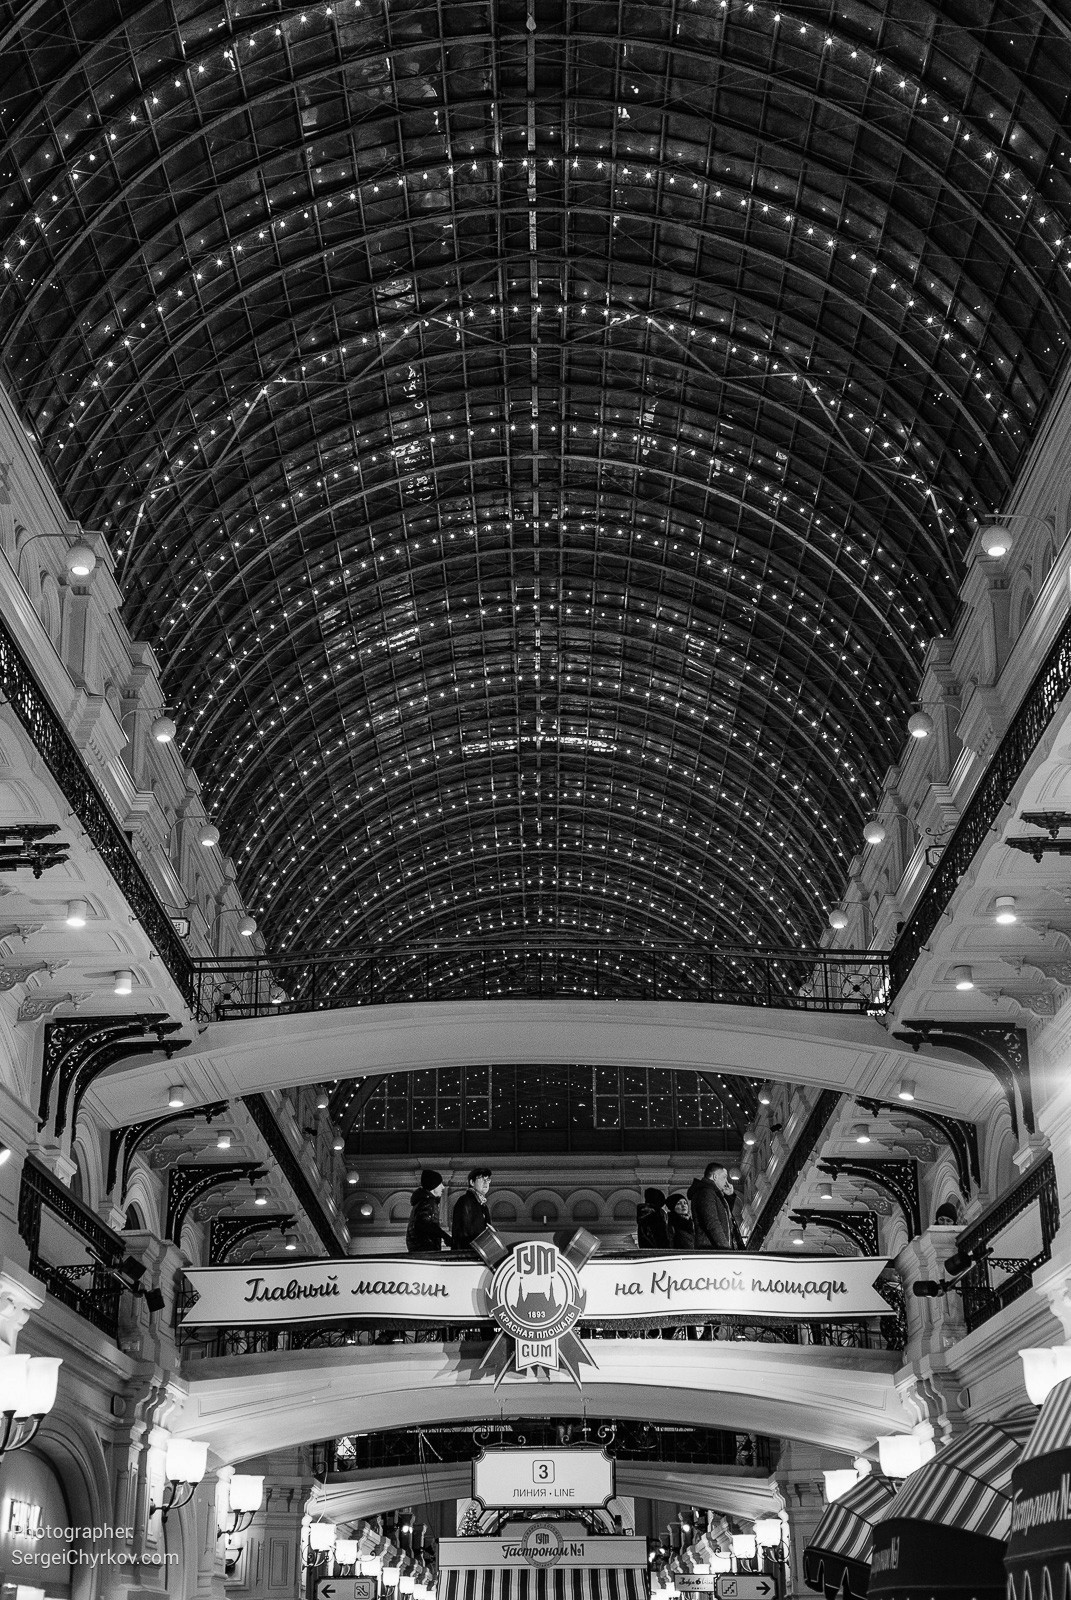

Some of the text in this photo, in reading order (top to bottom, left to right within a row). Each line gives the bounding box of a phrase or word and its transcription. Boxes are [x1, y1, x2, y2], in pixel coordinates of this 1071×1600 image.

[516, 1245, 556, 1275] ГУМ
[244, 1276, 449, 1302] Главный магазин
[615, 1271, 848, 1301] на Красной площади
[527, 1311, 546, 1319] 1893
[499, 1311, 575, 1339] КРАСНАЯ ПЛОЩАДЬ
[522, 1344, 552, 1357] GUM
[538, 1464, 549, 1479] 3
[512, 1488, 575, 1497] ЛИНИЯ LINE
[502, 1543, 584, 1559] Гастроном №1
